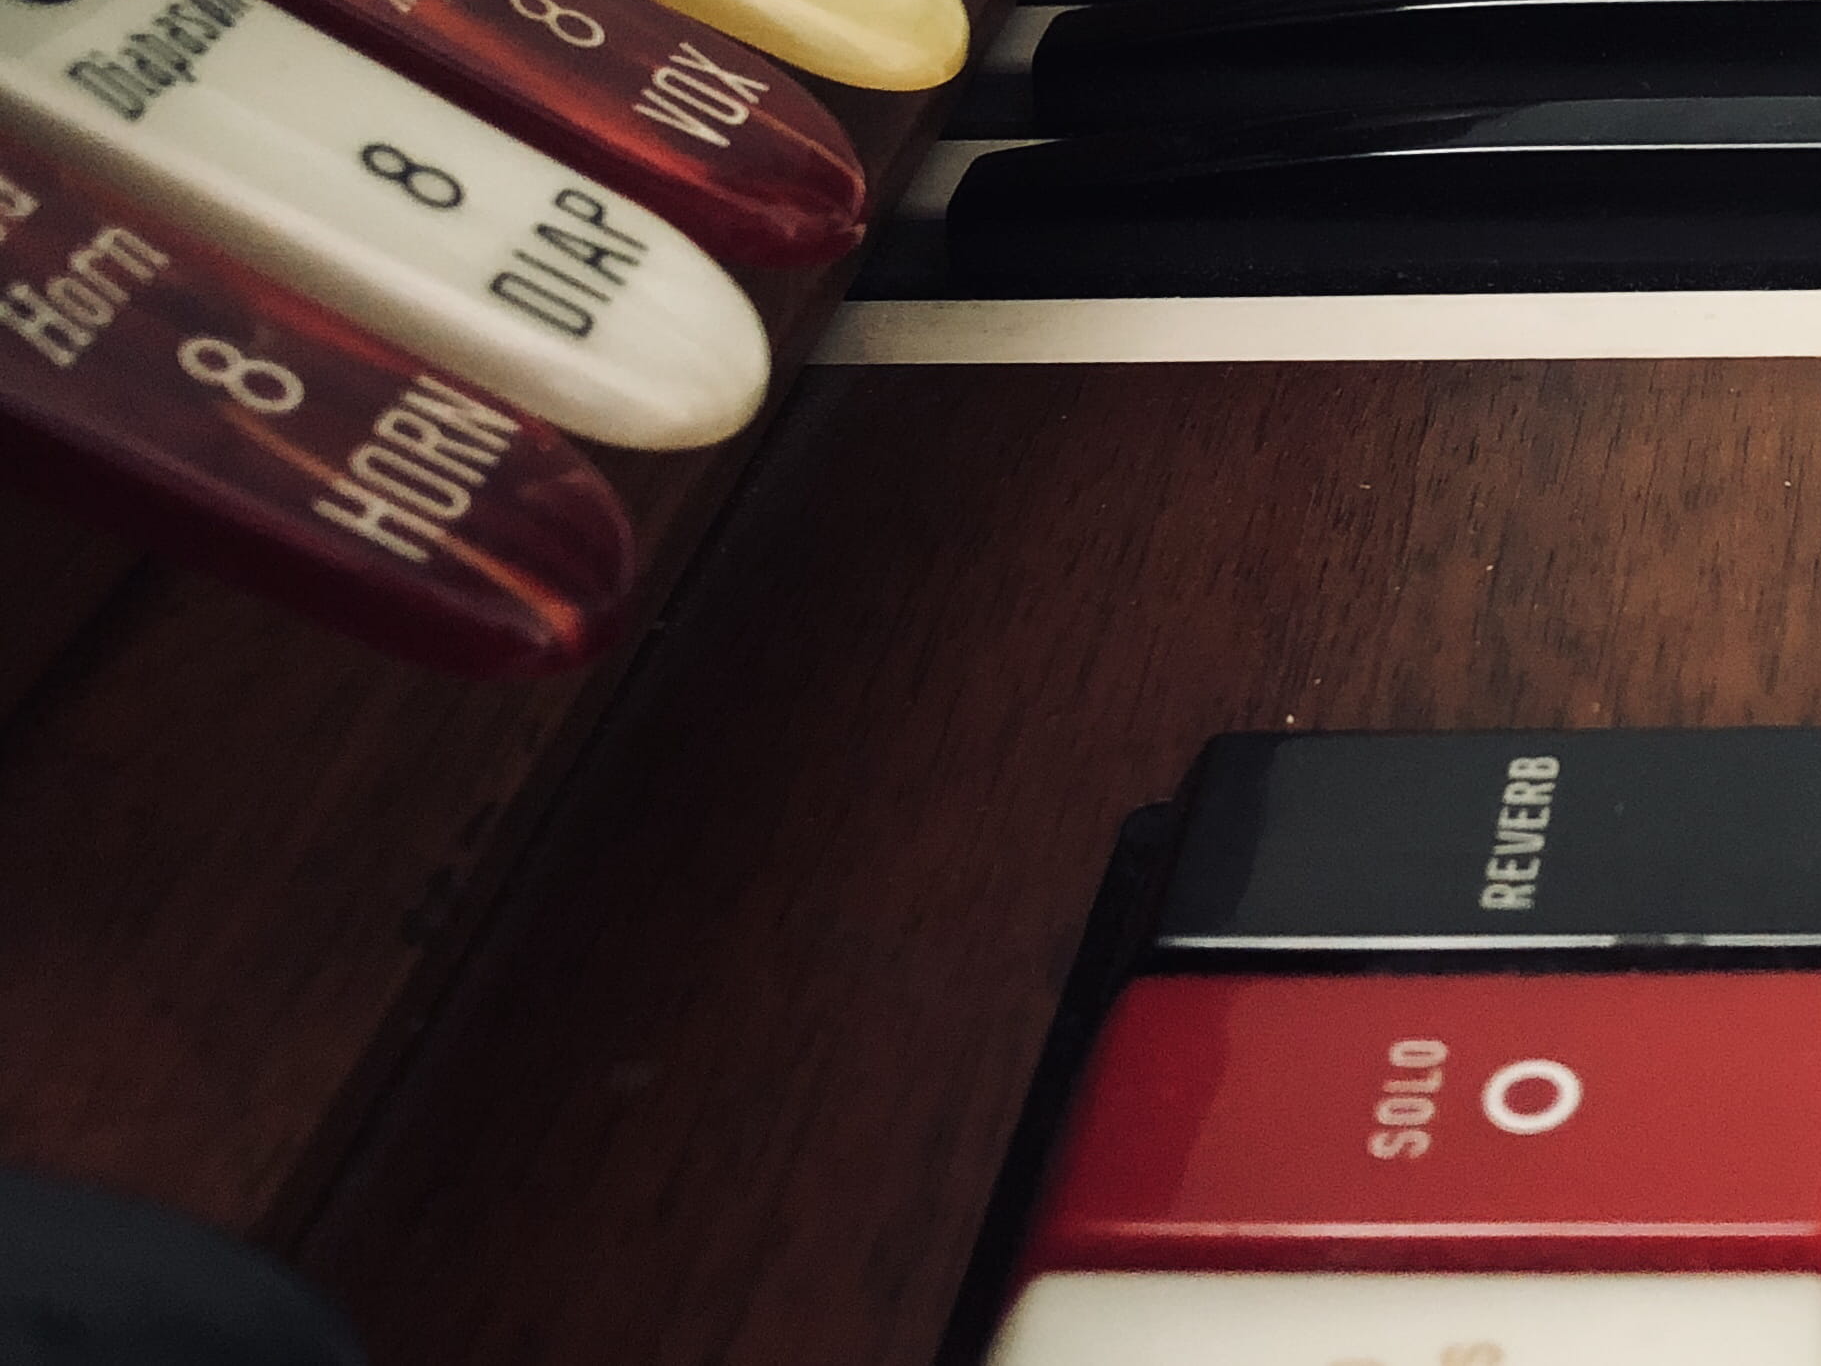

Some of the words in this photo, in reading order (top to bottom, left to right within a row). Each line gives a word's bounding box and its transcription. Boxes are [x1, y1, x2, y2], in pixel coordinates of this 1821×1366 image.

[632, 41, 771, 149] VOX
[360, 143, 466, 210] 8
[0, 227, 171, 369] Horn
[489, 187, 650, 340] DIAP
[177, 336, 306, 414] 8
[311, 374, 525, 564] HORN
[1478, 755, 1561, 911] REVERB
[1367, 1038, 1450, 1160] SOLO
